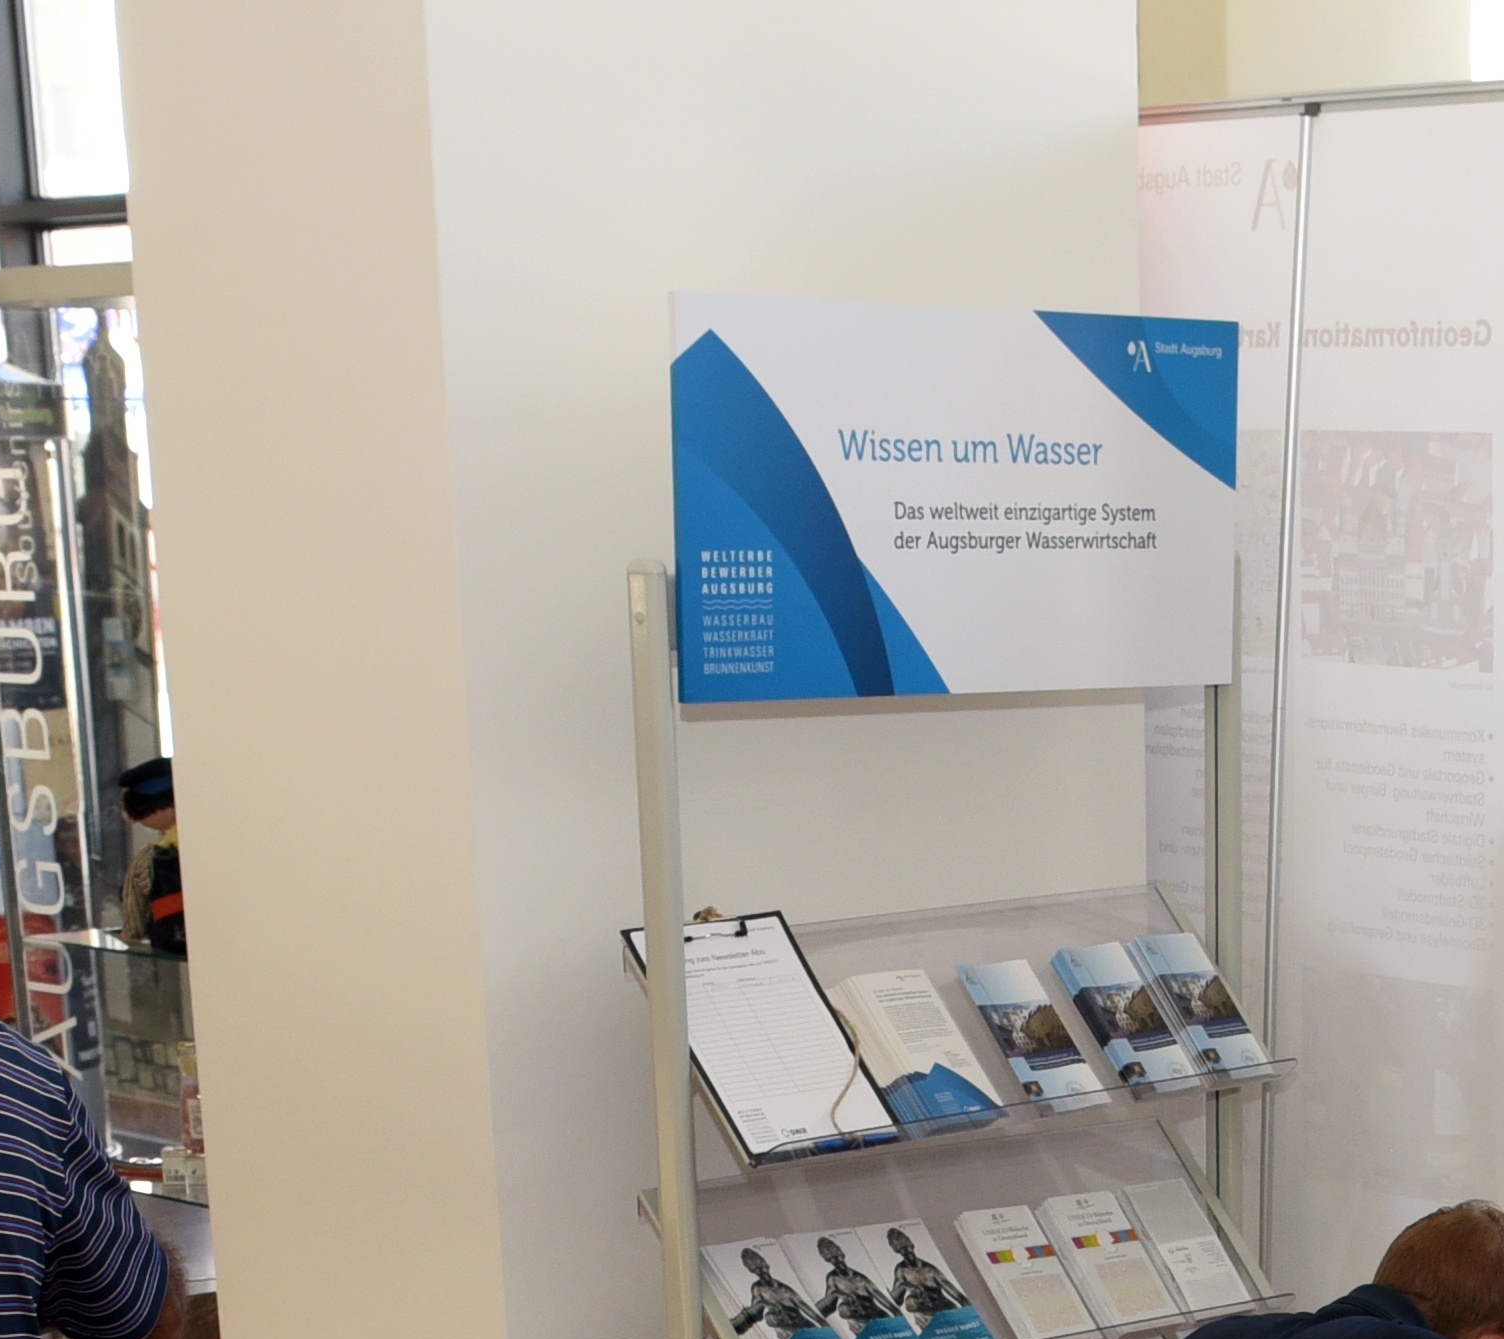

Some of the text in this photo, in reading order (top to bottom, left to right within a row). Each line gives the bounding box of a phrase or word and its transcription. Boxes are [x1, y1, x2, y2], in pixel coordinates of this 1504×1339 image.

[1155, 341, 1222, 360] Stadt Augsburg
[837, 428, 1104, 466] Wissen um Wasser
[894, 501, 1156, 527] Das weltweit einzigartige System
[894, 531, 1158, 554] der Augsburger Wasserwirtschaft
[700, 549, 774, 563] WELTERBE
[700, 566, 774, 579] BEWERBER
[701, 582, 774, 595] AUGSBURG
[702, 613, 774, 627] WASSERBAU
[702, 629, 774, 643] WASSERKRAFT
[703, 645, 775, 659] TRINKWASSER
[703, 661, 775, 675] BRUNNENKUNST
